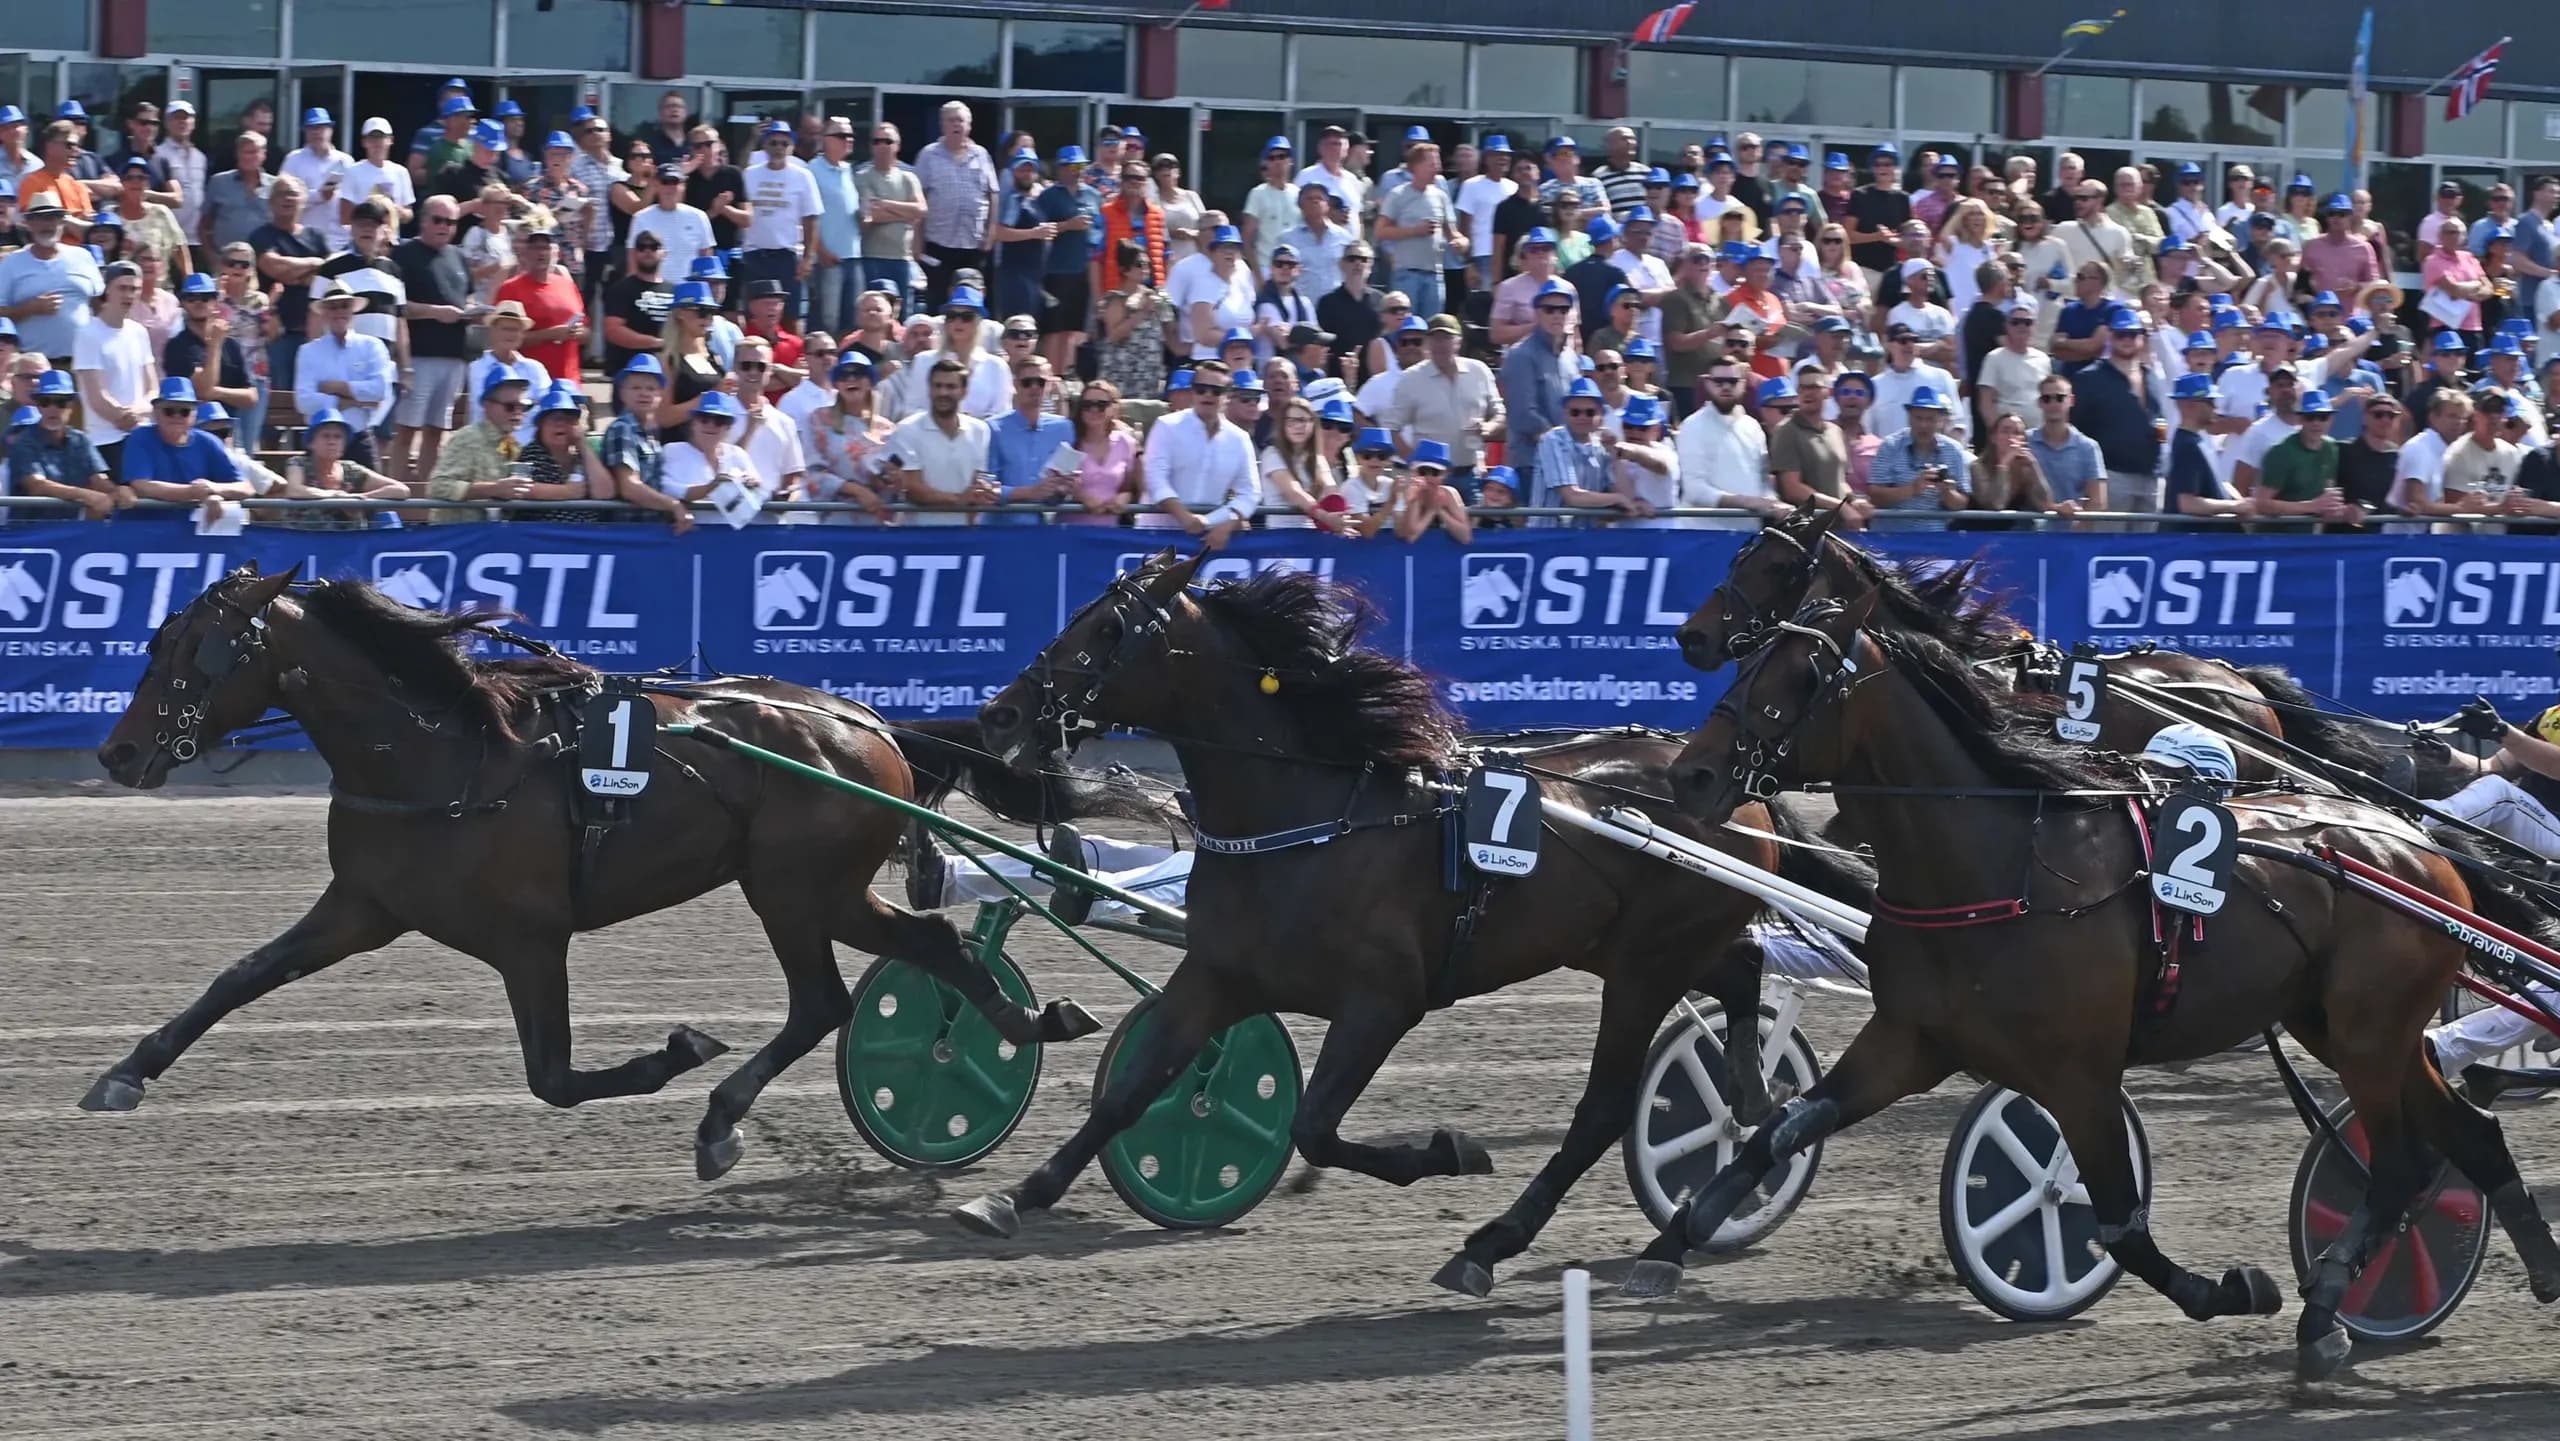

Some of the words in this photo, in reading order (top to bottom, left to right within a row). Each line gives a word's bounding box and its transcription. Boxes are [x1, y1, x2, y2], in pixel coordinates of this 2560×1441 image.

[465, 553, 639, 629] STL
[836, 555, 1007, 627] STL
[1535, 556, 1689, 625] STL
[2155, 560, 2295, 625] STL
[2448, 561, 2560, 625] STL
[753, 638, 864, 653] SVENSKA
[873, 638, 1005, 652] TRAVLIGAN
[1460, 636, 1561, 649] SVENSKA
[2088, 635, 2179, 649] SVENSKA
[2184, 635, 2294, 648] TRAVLIGAN
[2383, 634, 2472, 648] SVENSKA
[1449, 674, 1697, 707] svenskatravligan.se
[2066, 661, 2098, 720] 5
[2371, 669, 2560, 700] svenskatravligan.
[608, 700, 631, 768] 1
[602, 776, 639, 789] LinSon
[1485, 771, 1527, 843] 7
[1491, 853, 1528, 869] LinSon
[2168, 806, 2222, 887] 2
[2174, 886, 2214, 908] LinSon
[2459, 926, 2516, 964] bravida
